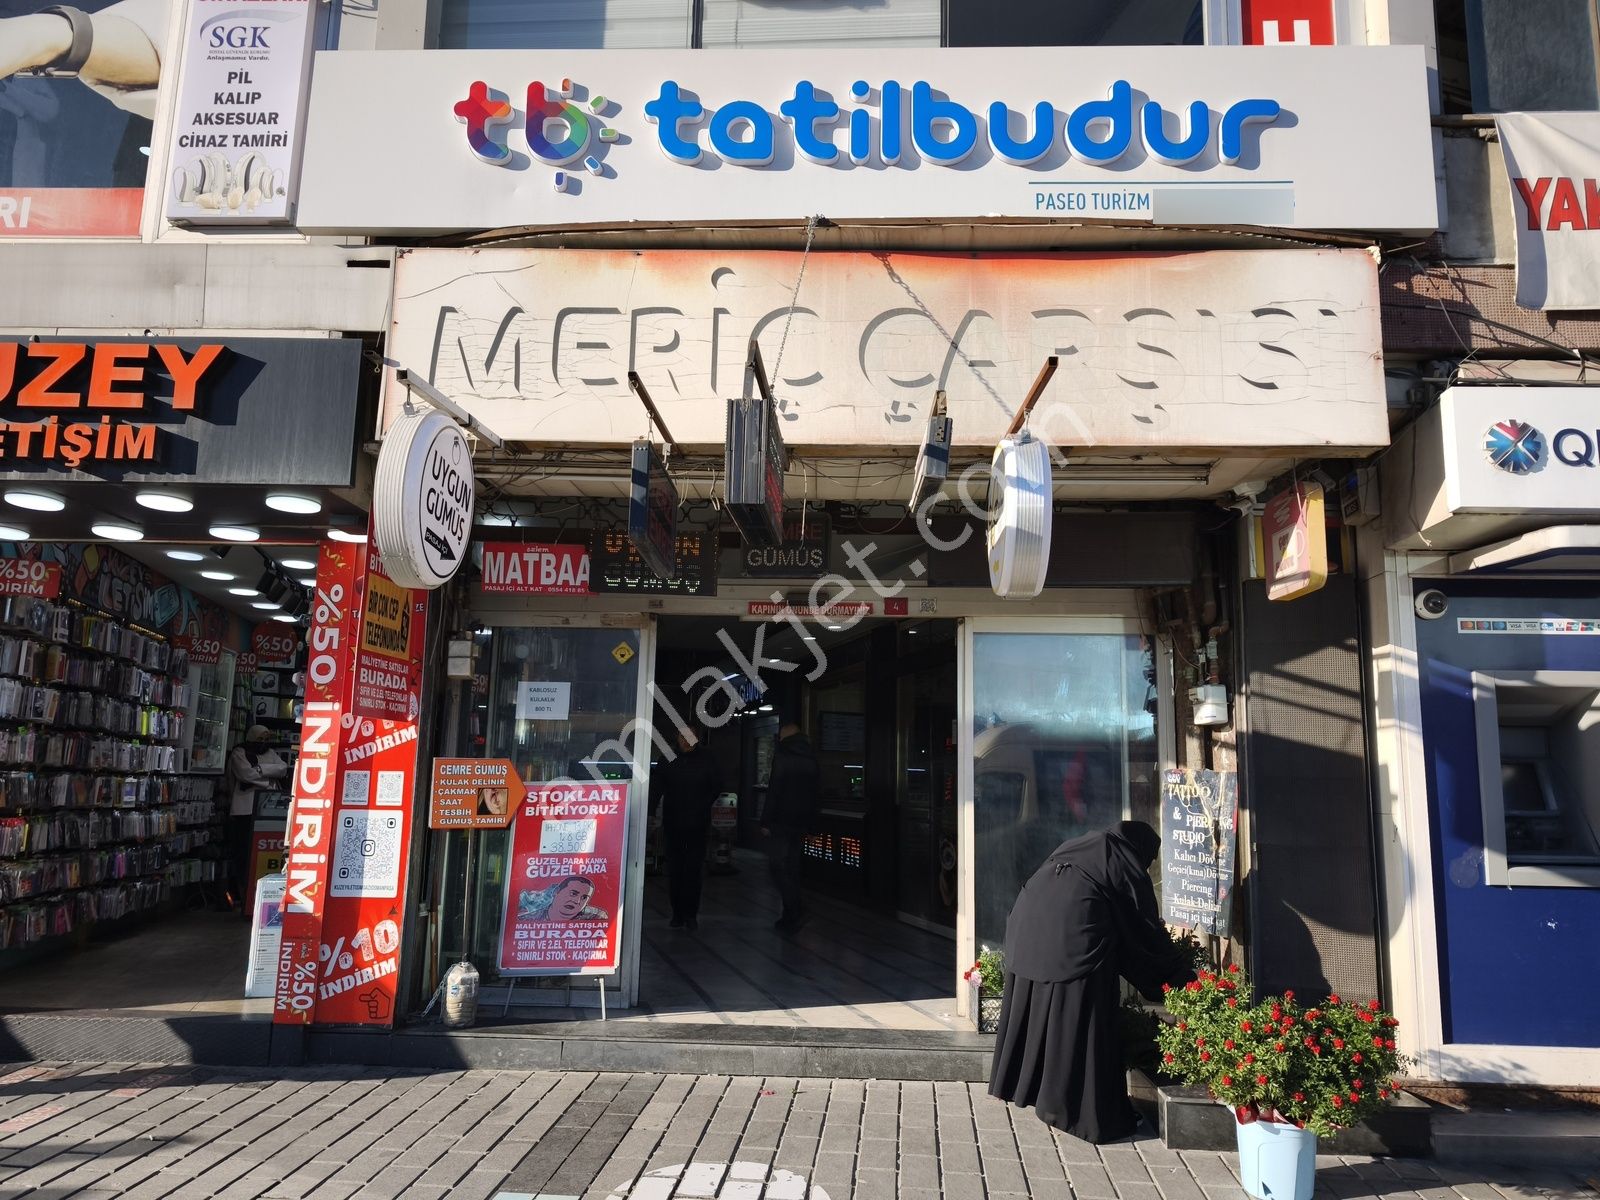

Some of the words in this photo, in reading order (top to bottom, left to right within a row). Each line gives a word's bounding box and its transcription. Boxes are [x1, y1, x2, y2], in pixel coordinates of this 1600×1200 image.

[209, 25, 271, 48] SGK
[227, 67, 252, 84] PİL
[213, 91, 262, 105] KALIP
[192, 112, 279, 125] AKSESUAR
[644, 79, 1281, 164] tatilbudur
[178, 131, 229, 148] CİHAZ
[232, 130, 288, 148] TAMİRİ
[1035, 192, 1087, 210] PASEO
[1090, 188, 1150, 210] TURİZM
[0, 415, 156, 467] TİŞİM
[1552, 428, 1600, 468] Q
[432, 450, 472, 513] UYGUN
[426, 487, 465, 546] GÜMÜŞ
[746, 546, 824, 569] GÜMÜŞ
[484, 551, 591, 586] MATBAA
[255, 634, 293, 653] %50
[310, 583, 344, 685] %50
[359, 667, 408, 691] BURADA
[344, 724, 418, 765] İNDİRİM
[440, 764, 472, 775] CEMRE
[438, 788, 477, 796] ÇAKMAK
[526, 789, 620, 803] STOKLARI
[287, 700, 342, 914] İNDİRİM
[439, 798, 463, 806] SAAT
[525, 803, 619, 817] BİTİRİYORUZ
[475, 816, 506, 824] TAMİRİ
[562, 857, 584, 865] PARA
[585, 857, 608, 865] KANKA
[579, 863, 607, 875] PARA
[1181, 878, 1213, 898] Piercing
[1170, 905, 1189, 923] Pasaj
[514, 929, 608, 939] BURADA
[568, 922, 609, 930] SATIŞLAR
[319, 919, 399, 978] %10
[517, 940, 535, 950] SIFIR
[537, 940, 547, 949] VE
[564, 939, 608, 949] TELEFONLAR
[516, 951, 544, 961] SINIRLI
[546, 951, 566, 960] STOK
[572, 950, 607, 962] KAÇIRMA
[275, 941, 296, 1010] İNDİRİM
[291, 960, 317, 1010] %50
[319, 956, 398, 1001] İNDİRİM
